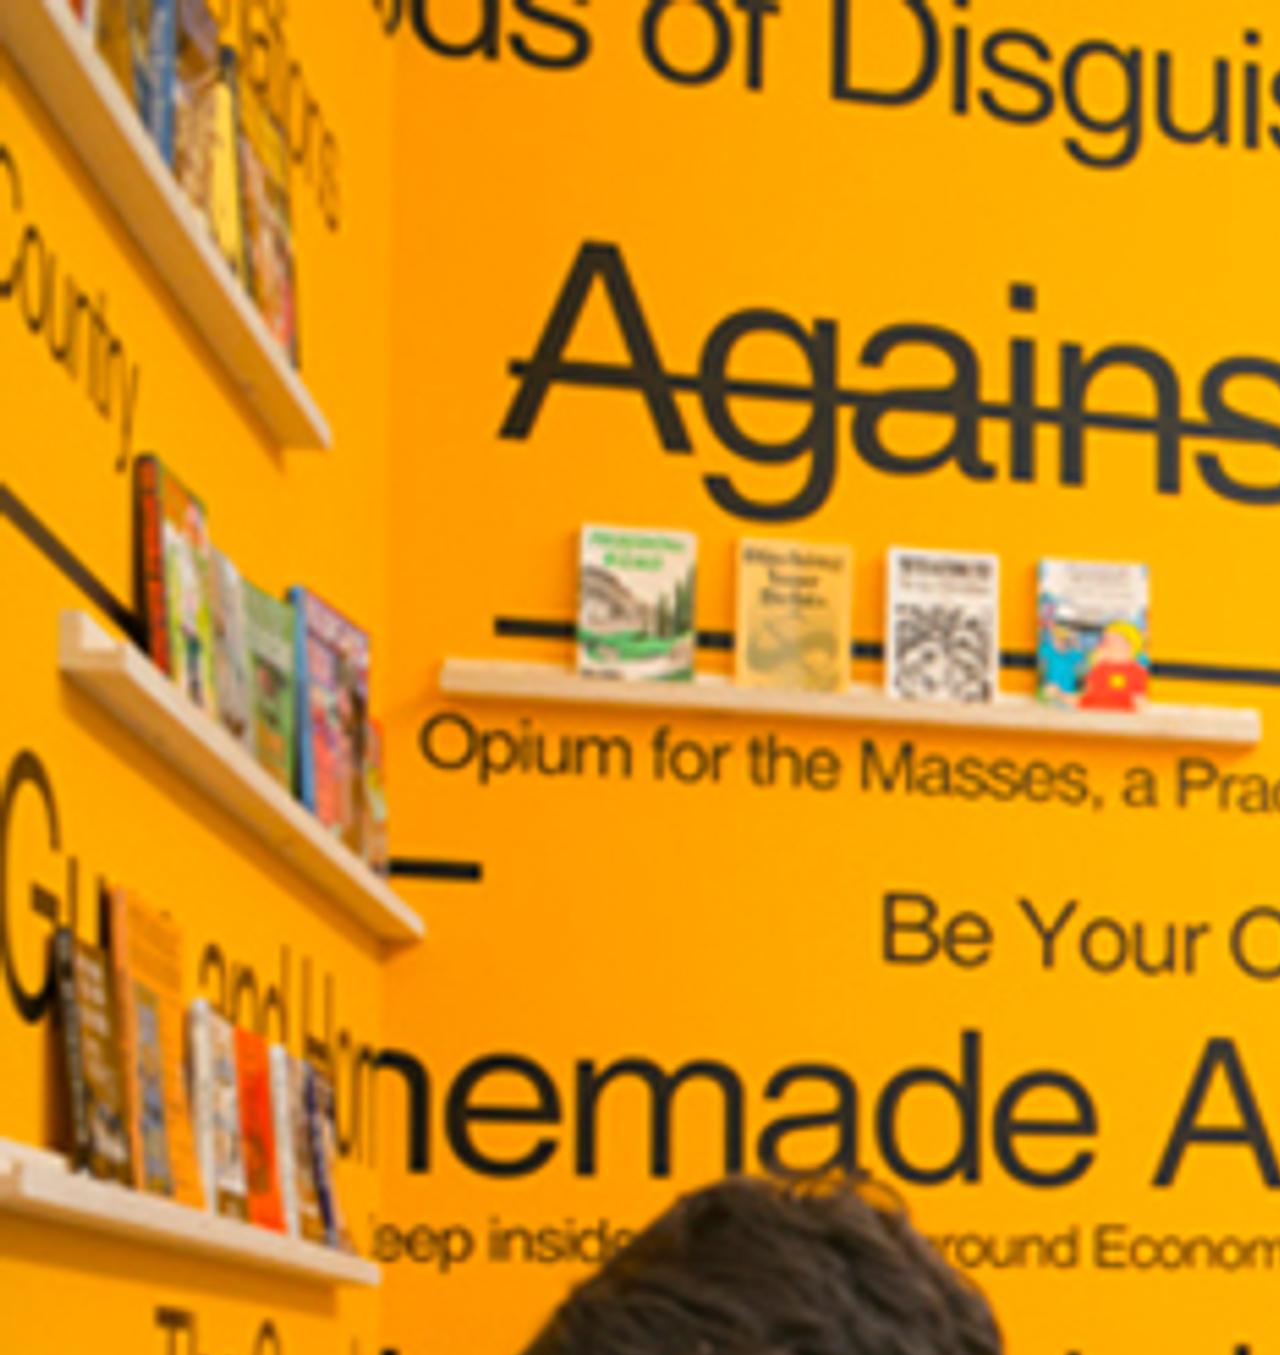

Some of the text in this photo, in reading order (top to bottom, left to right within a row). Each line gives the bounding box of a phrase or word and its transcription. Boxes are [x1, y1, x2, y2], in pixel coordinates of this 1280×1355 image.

[416, 708, 634, 786] Opium
[650, 722, 733, 785] for
[746, 730, 843, 792] the
[859, 736, 1103, 809] Masses,
[1121, 766, 1158, 808] a
[881, 890, 994, 970] Be
[1017, 896, 1211, 977] Your
